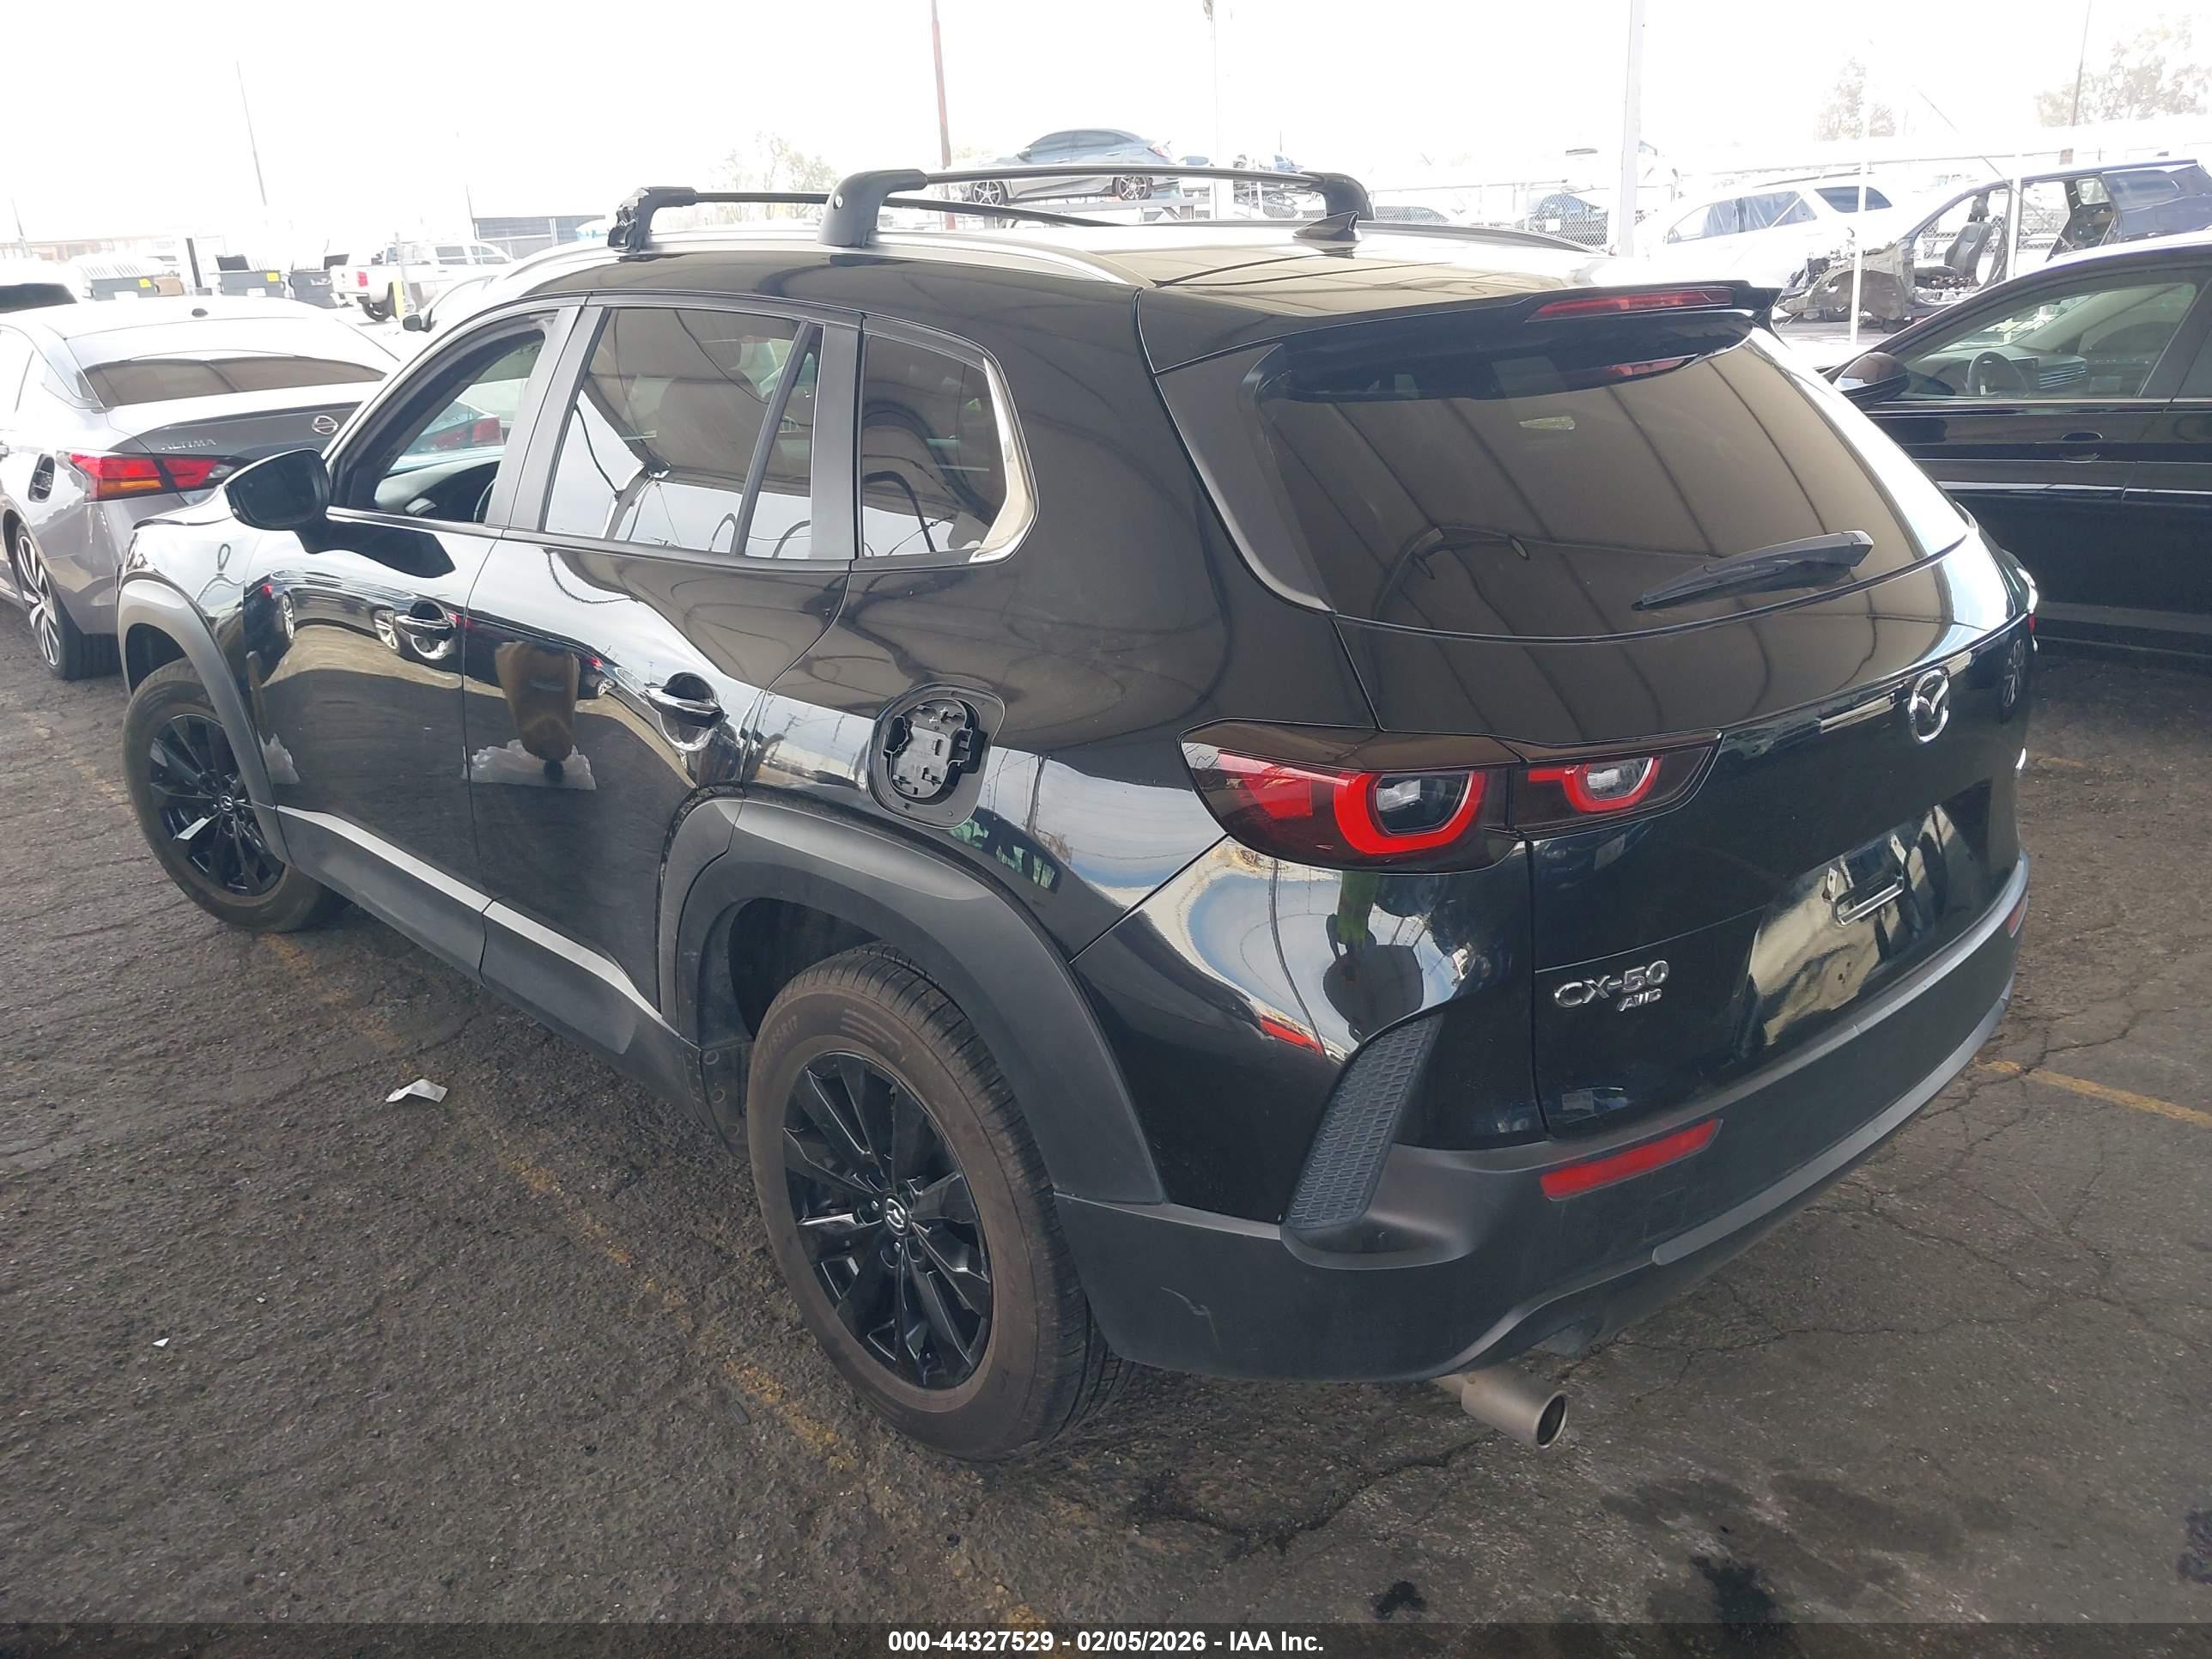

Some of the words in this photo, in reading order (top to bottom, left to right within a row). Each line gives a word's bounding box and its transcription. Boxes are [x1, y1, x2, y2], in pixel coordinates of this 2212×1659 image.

[161, 439, 218, 451] ALTIMA
[1553, 959, 1670, 1008] CX-50
[1616, 988, 1662, 1012] AWD
